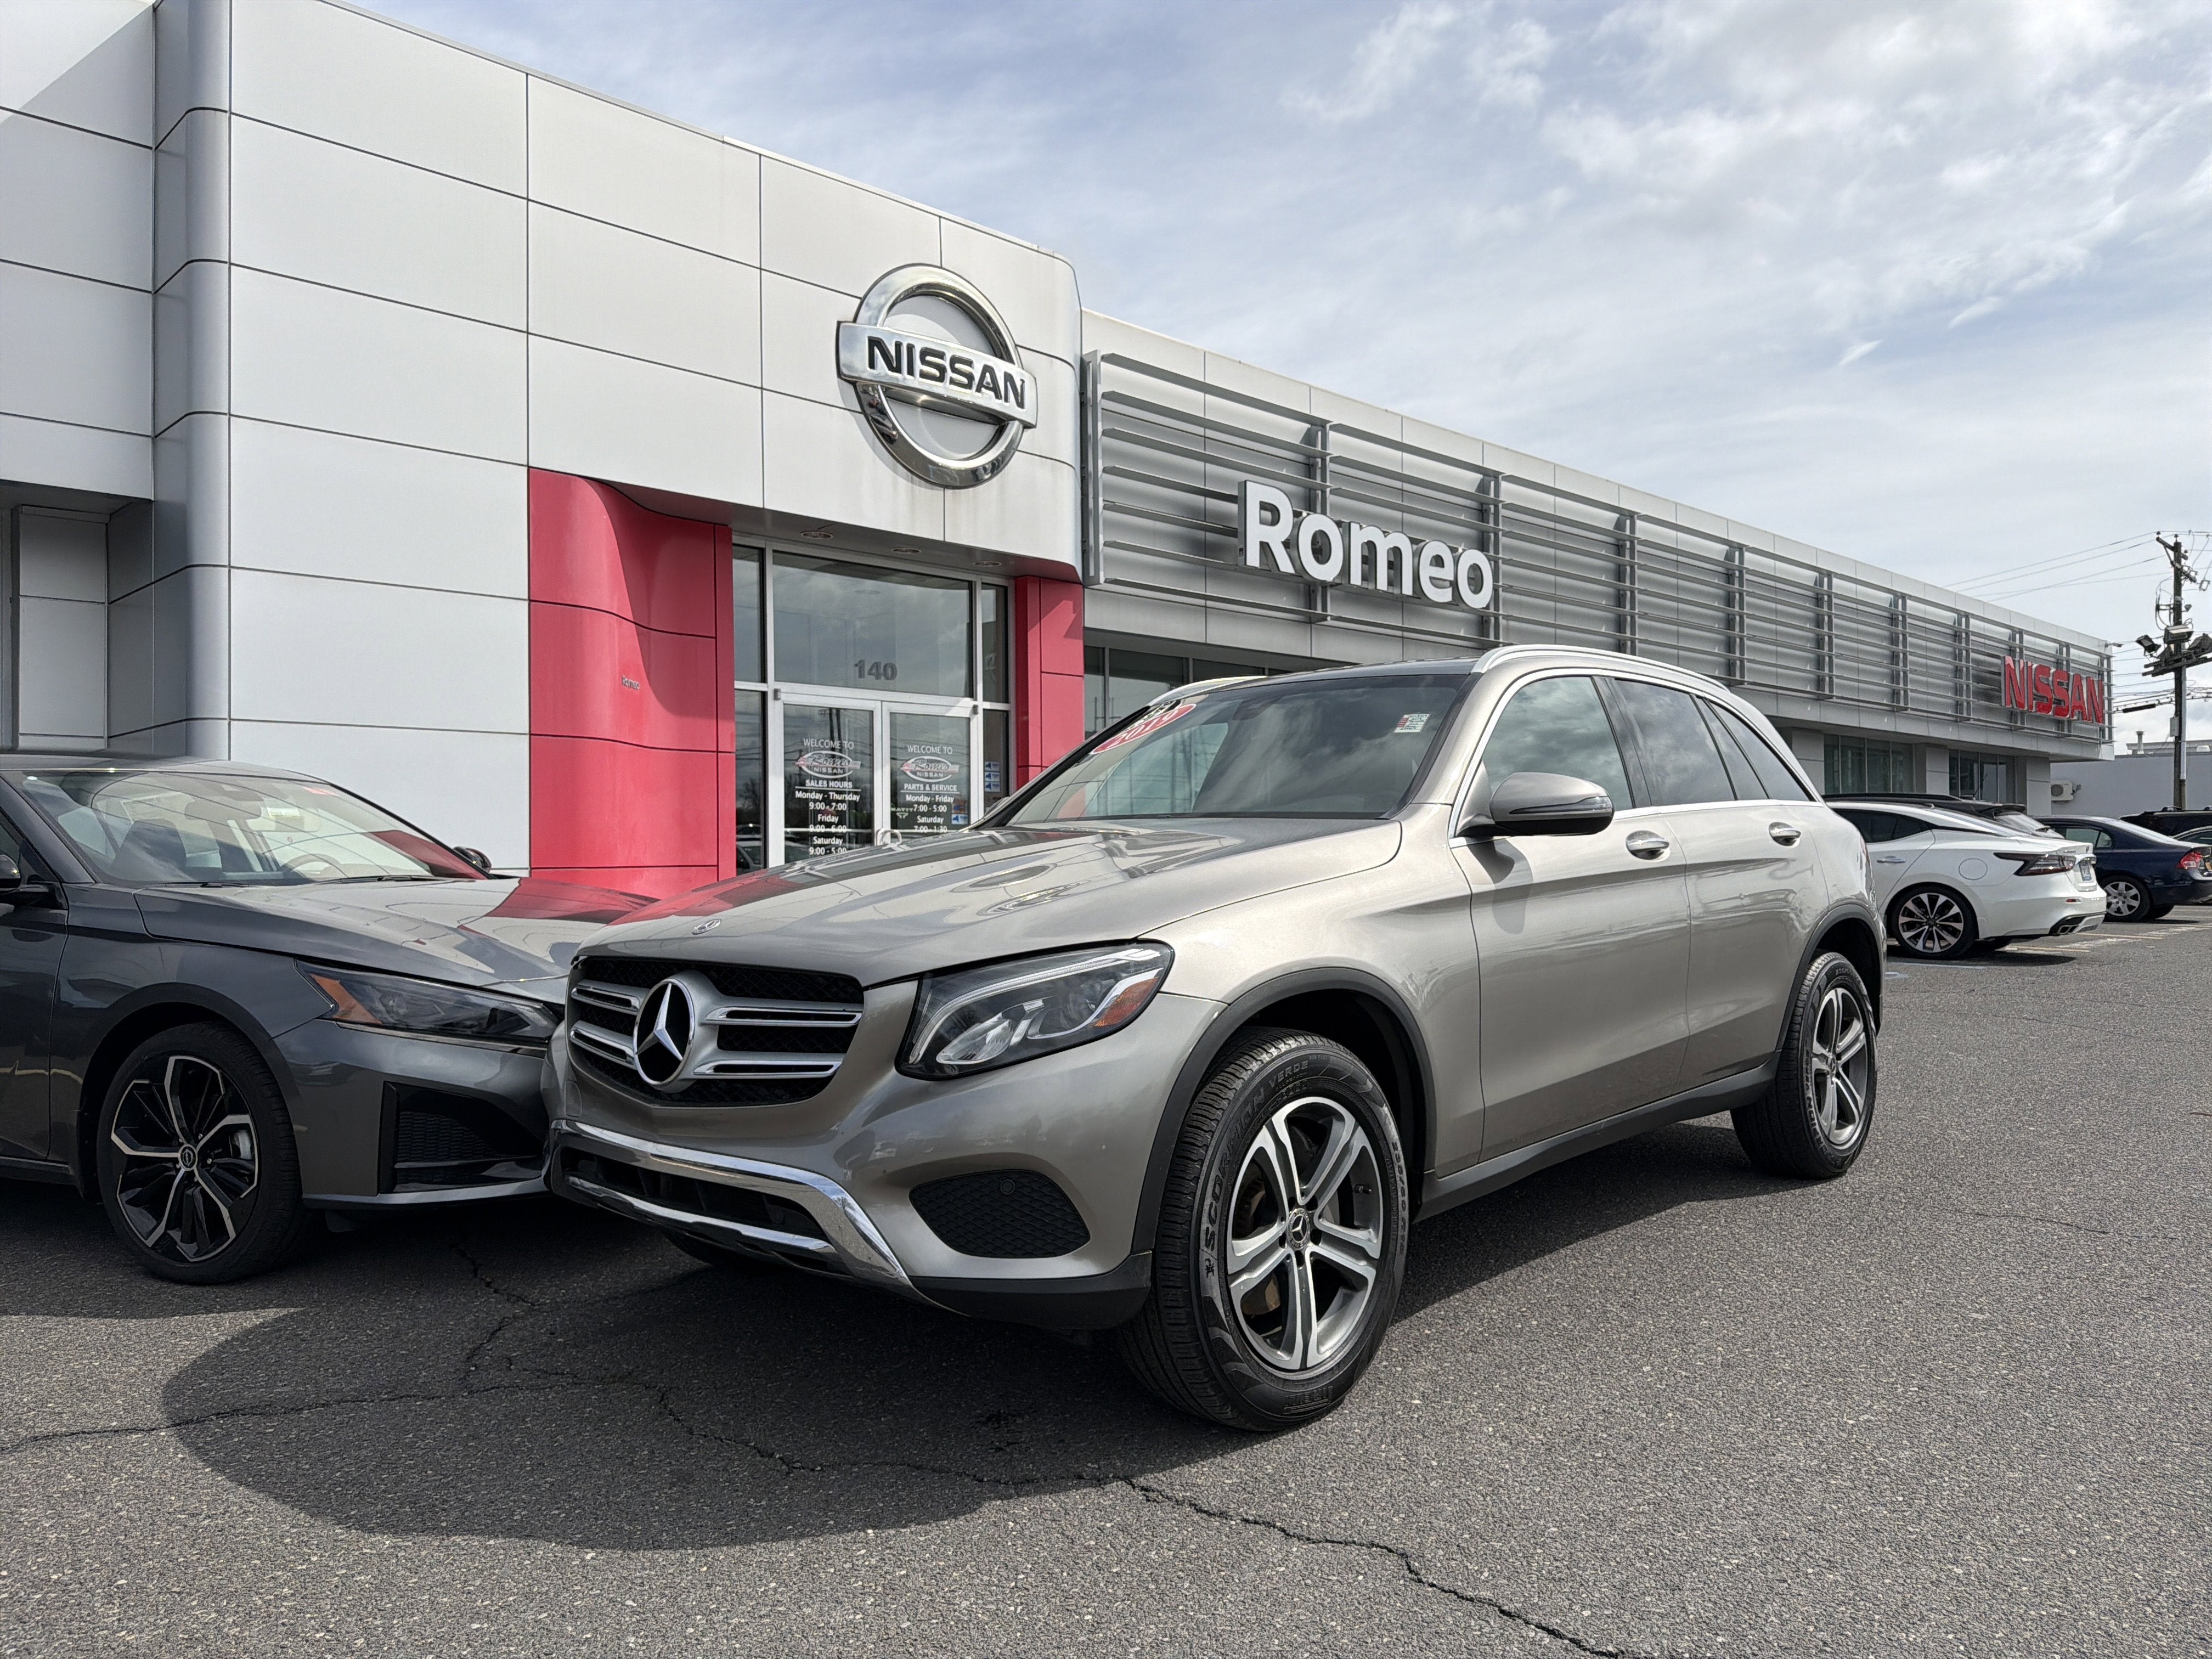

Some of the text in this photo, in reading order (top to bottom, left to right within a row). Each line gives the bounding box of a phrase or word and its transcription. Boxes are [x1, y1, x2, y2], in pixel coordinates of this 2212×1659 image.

[867, 336, 1027, 411] NISSAN
[1242, 479, 1493, 609] Romeo
[854, 659, 898, 680] 140
[2004, 656, 2104, 725] NISSAN
[803, 738, 854, 749] WELCOME TO
[907, 745, 941, 754] WELCOME
[805, 779, 827, 787] SALES
[795, 791, 823, 800] Monday
[828, 792, 860, 802] Thursday
[906, 794, 930, 803] Monday
[935, 795, 954, 803] Friday
[809, 802, 825, 810] 9:00
[831, 803, 847, 811] 7:00
[817, 814, 839, 823] Friday
[917, 815, 944, 823] Saturday
[812, 836, 843, 845] Saturday
[1269, 1060, 1308, 1088] VERDE
